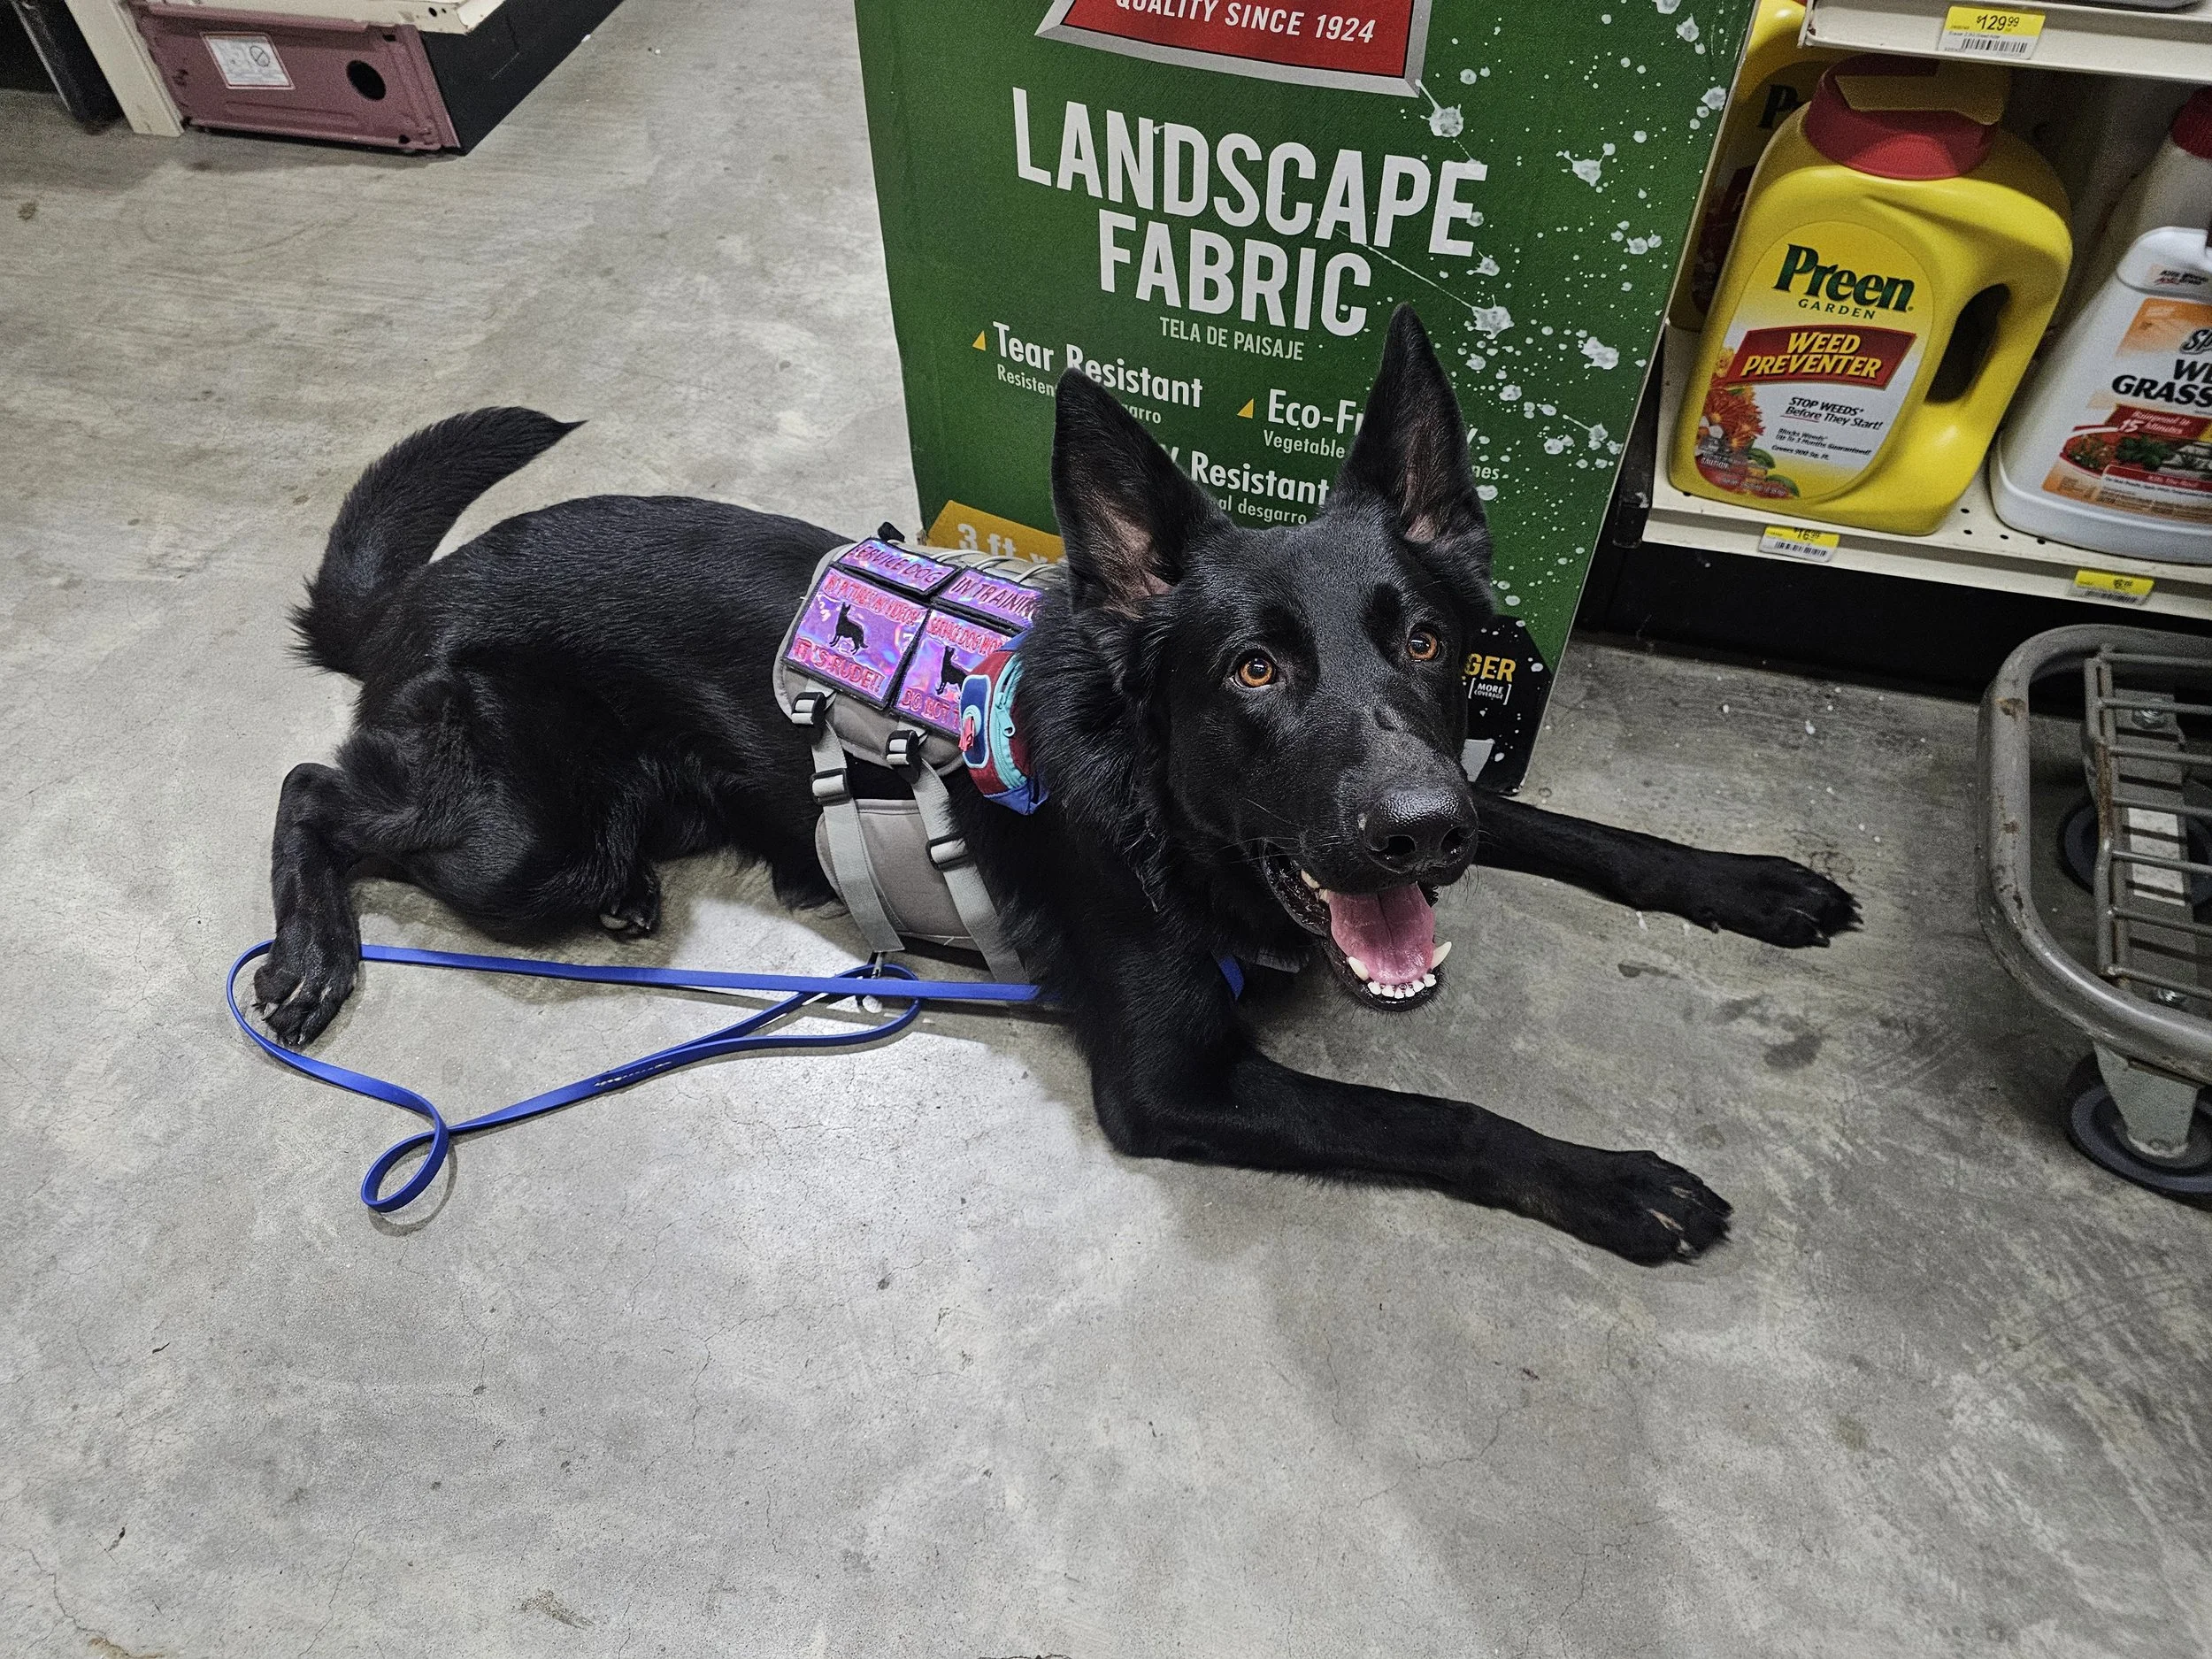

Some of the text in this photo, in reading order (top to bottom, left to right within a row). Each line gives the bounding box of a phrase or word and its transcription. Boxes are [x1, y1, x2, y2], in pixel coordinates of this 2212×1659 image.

[1225, 2, 1305, 36] SINCE
[1315, 14, 1377, 43] 1924
[1012, 87, 1488, 257] LANDSCAPE
[1098, 209, 1372, 337] FABRIC
[1771, 243, 1916, 313] Preen
[1798, 298, 1877, 320] GARDEN
[1159, 316, 1304, 361] TELA DE PAISAJE
[1787, 331, 1861, 355] WEED
[993, 321, 1203, 408] Tear Resistant
[1740, 354, 1883, 379] PREVENTER
[1788, 396, 1819, 408] STOP
[2112, 374, 2212, 407] GRASS
[1785, 406, 1884, 430] Before They Start!
[2118, 419, 2146, 434] 15
[1263, 429, 1346, 459] Vegetable
[1191, 450, 1330, 505] Resistant
[1218, 495, 1308, 525] al desgarro
[902, 563, 943, 583] DOG
[950, 577, 972, 595] IN
[1474, 690, 1504, 700] COVERAGE
[1477, 682, 1504, 694] MORE
